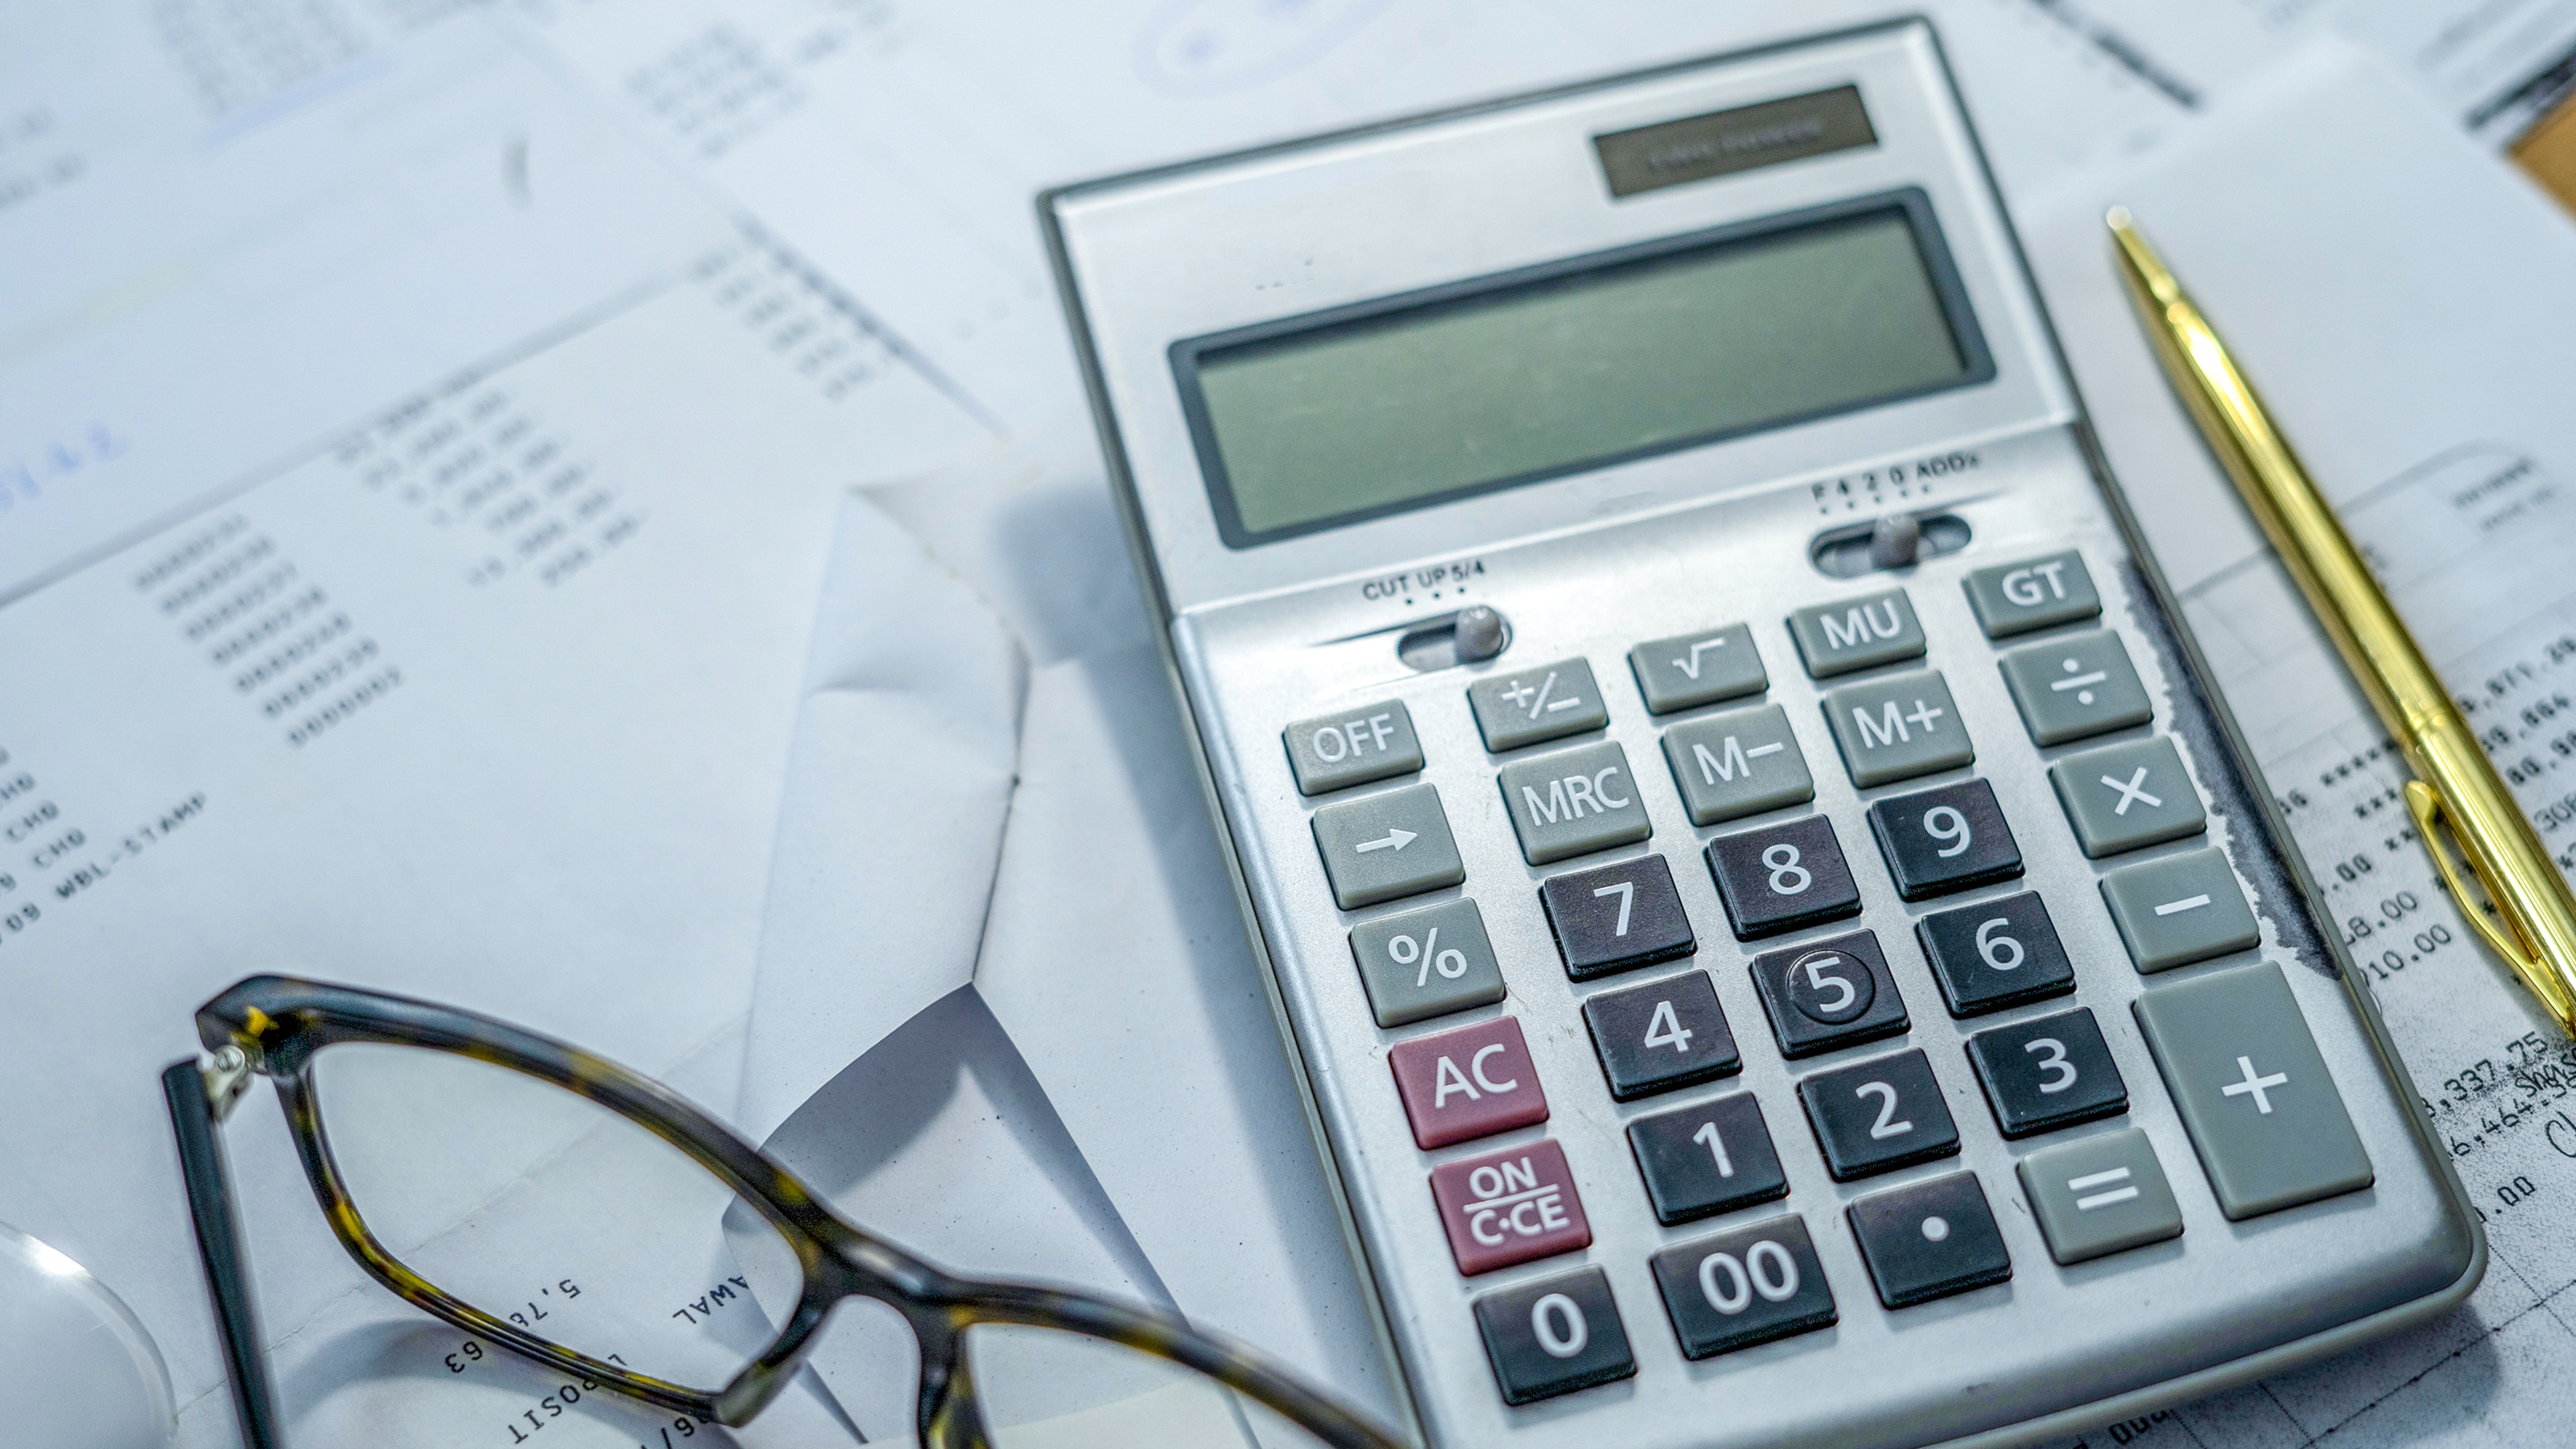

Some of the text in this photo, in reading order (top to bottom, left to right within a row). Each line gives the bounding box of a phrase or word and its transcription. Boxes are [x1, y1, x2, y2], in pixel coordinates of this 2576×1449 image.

[1362, 560, 1486, 601] CUT UP 5/4
[2001, 562, 2066, 607] GT
[1819, 599, 1901, 650] MU
[1312, 713, 1393, 762] OFF
[1852, 699, 1942, 749] M+
[1521, 766, 1629, 827] MRC
[1923, 806, 1972, 857] 9
[1761, 843, 1812, 895] 8
[2320, 852, 2373, 897] .00
[1593, 881, 1634, 936] 7
[1388, 927, 1468, 987] %
[1975, 917, 2025, 971] 6
[1805, 956, 1856, 1013] 5
[1644, 1000, 1693, 1053] 4
[1435, 1043, 1517, 1108] AC
[2024, 1038, 2078, 1093] 3
[1856, 1081, 1913, 1140] 2
[1693, 1121, 1734, 1178] 1
[1468, 1157, 1538, 1199] ON
[1698, 1240, 1799, 1315] 00
[1531, 1293, 1588, 1358] 0
